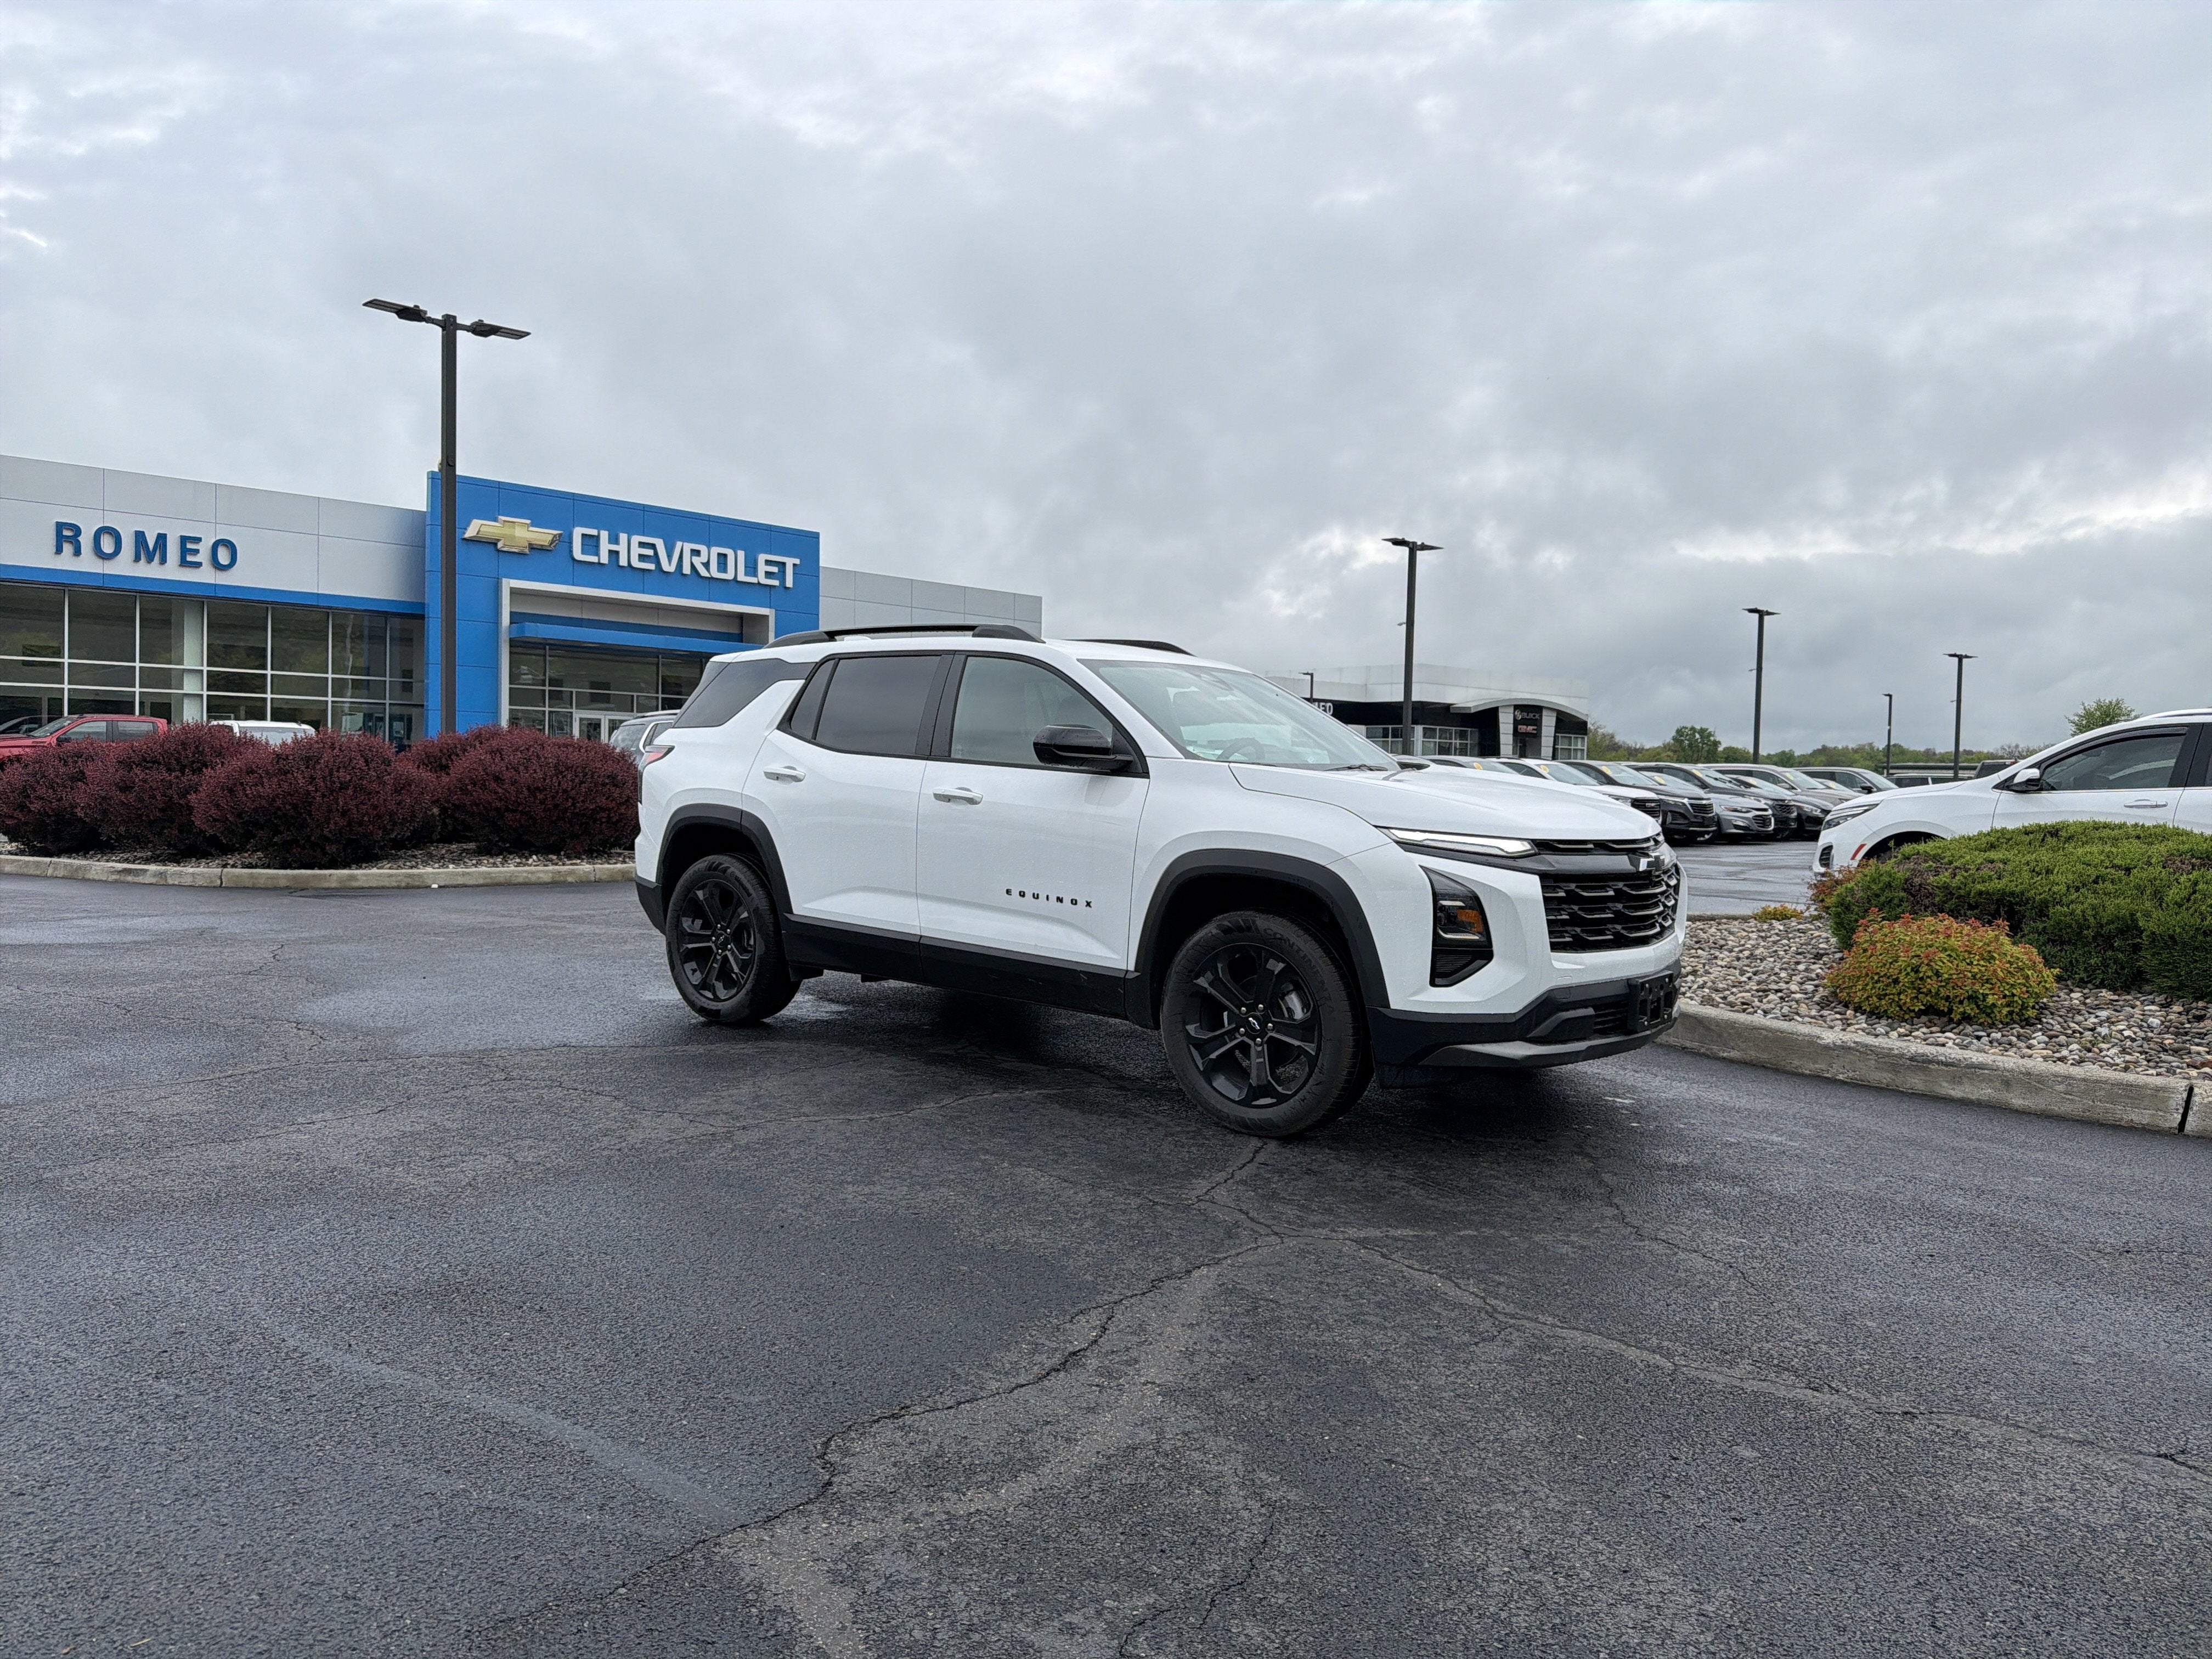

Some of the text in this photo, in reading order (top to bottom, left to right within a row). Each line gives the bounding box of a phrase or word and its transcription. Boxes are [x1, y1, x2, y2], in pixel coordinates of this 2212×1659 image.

[54, 521, 238, 571] ROMEO
[572, 527, 800, 588] CHEVROLET
[1518, 725, 1537, 733] GMC
[1006, 888, 1092, 909] EQUINOX
[1263, 928, 1336, 1022] CONTINENTA
